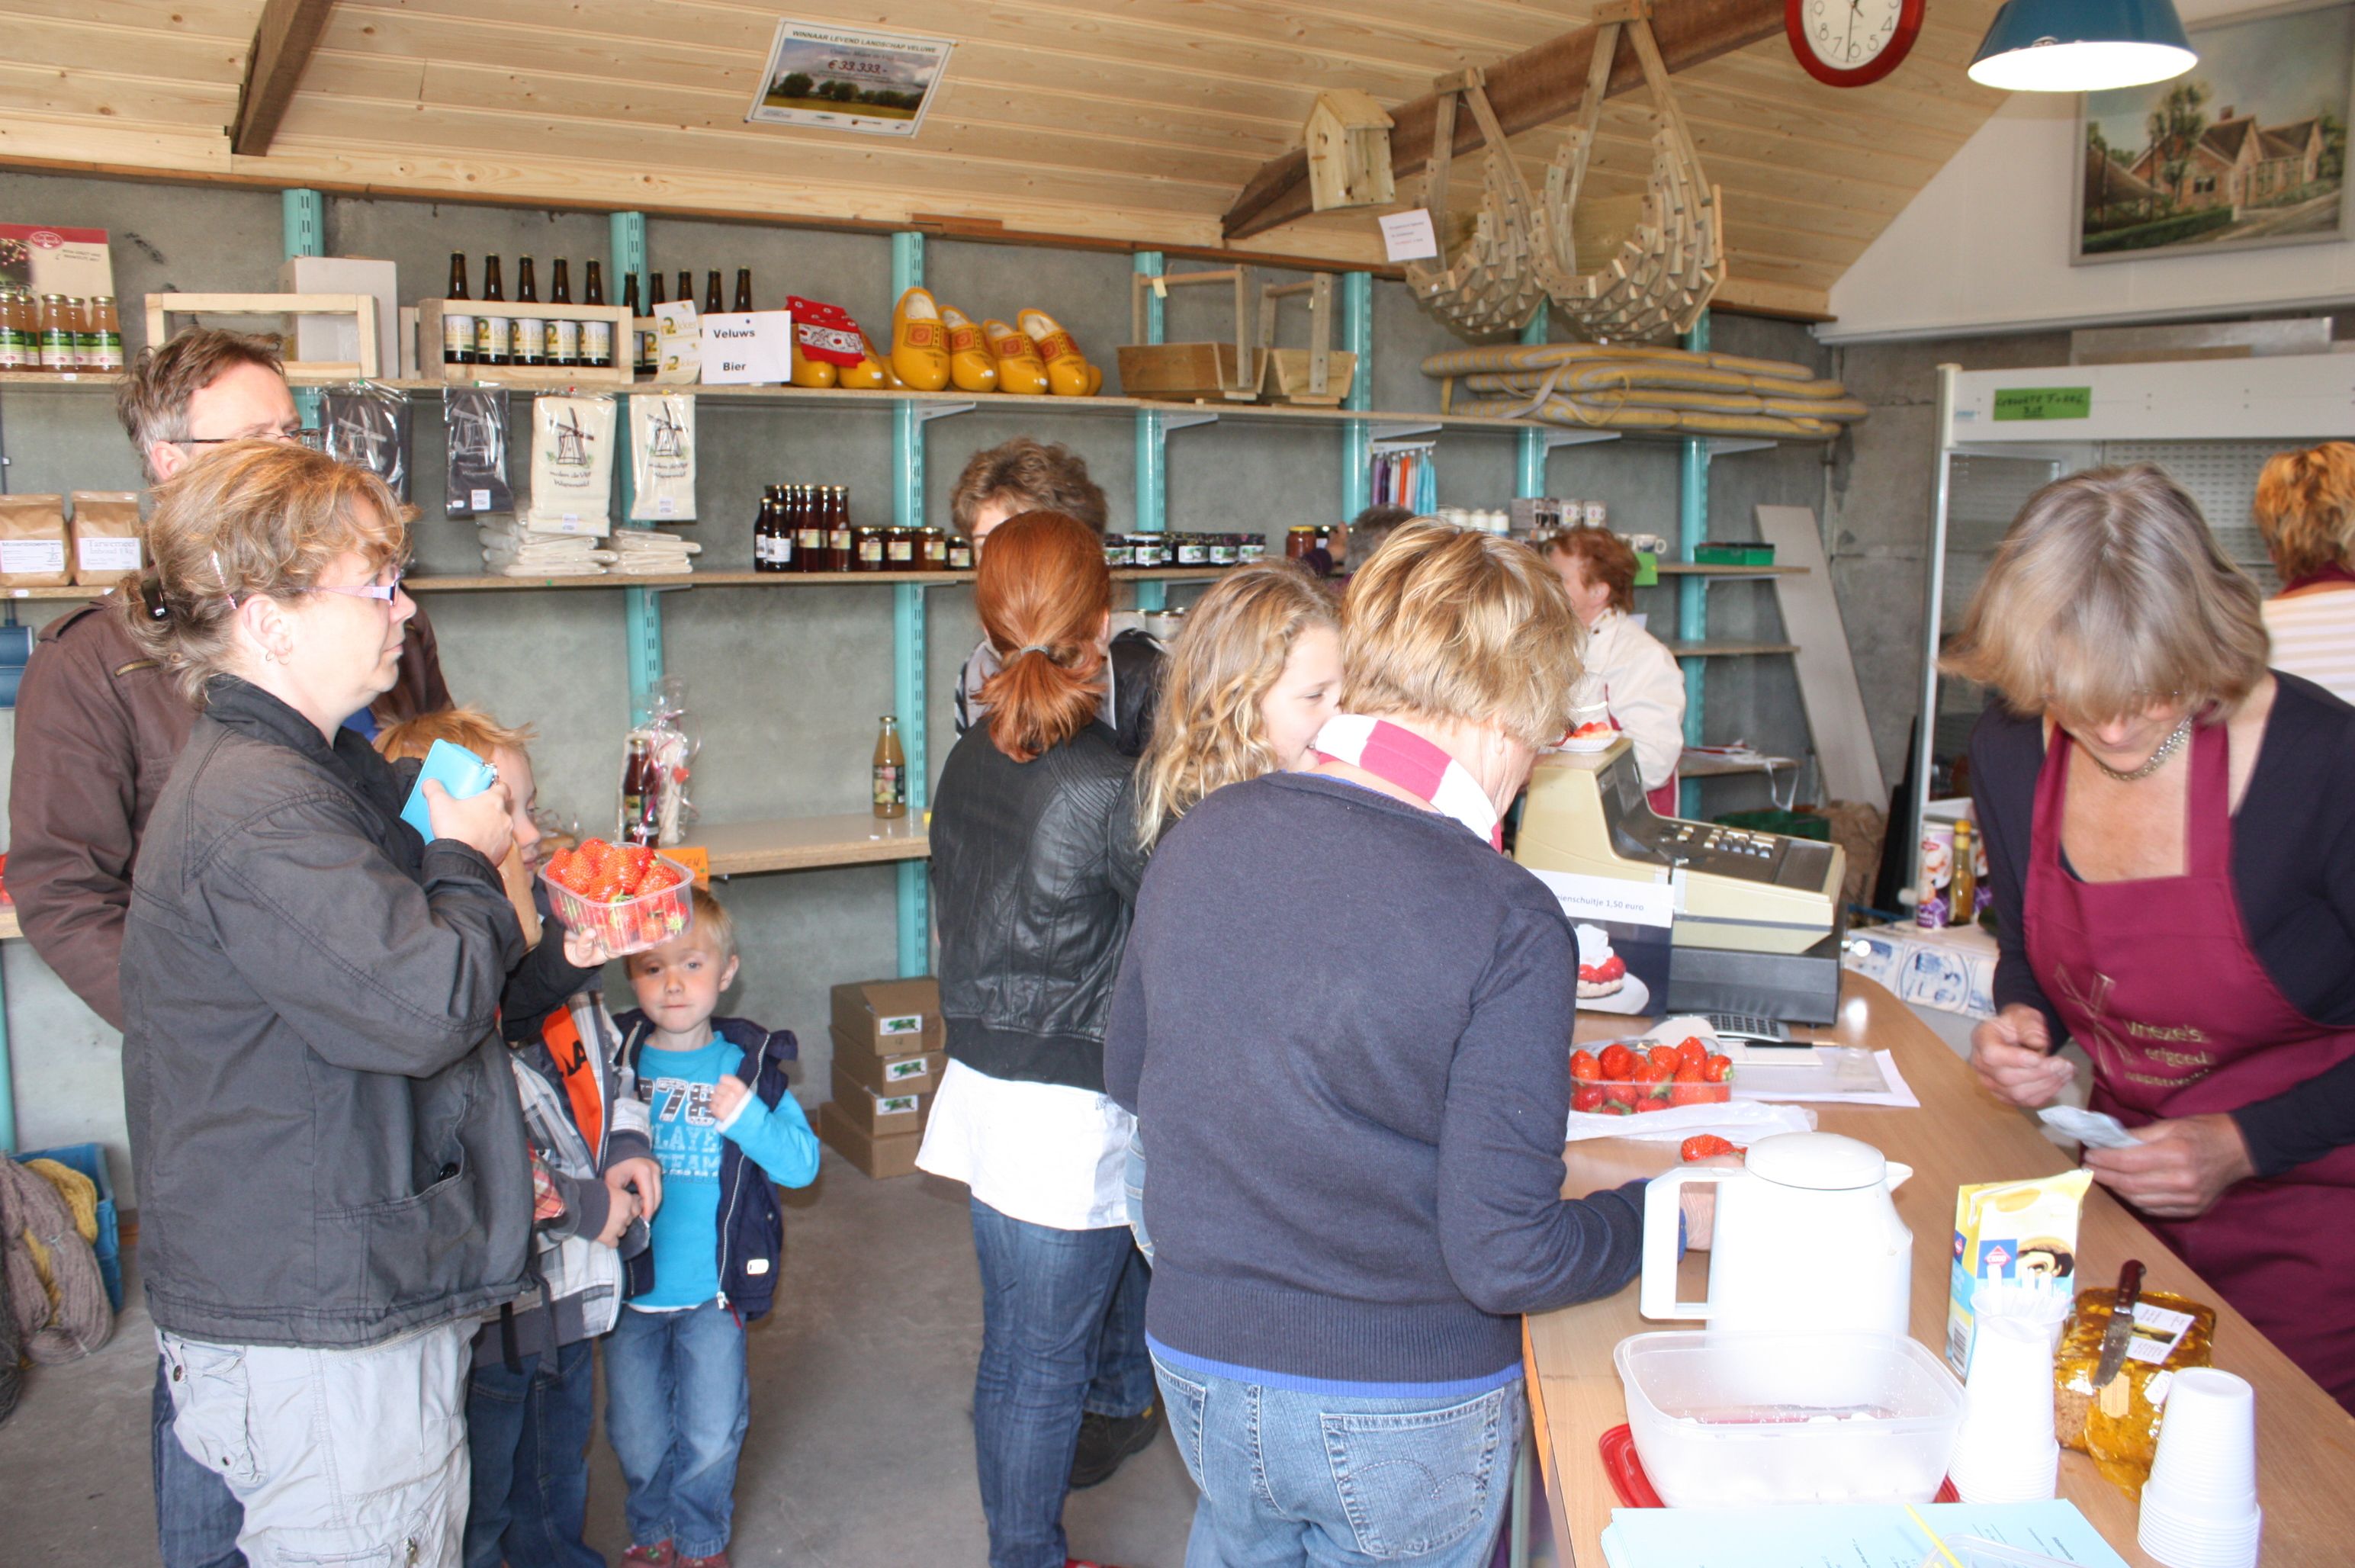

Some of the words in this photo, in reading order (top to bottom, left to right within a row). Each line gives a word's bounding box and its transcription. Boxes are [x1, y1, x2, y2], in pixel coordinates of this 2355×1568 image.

[1881, 15, 1892, 31] 4
[1820, 23, 1830, 41] 8
[792, 30, 828, 41] WINNAAR
[830, 35, 859, 45] LEVEND
[860, 39, 906, 50] LANDSCHAP
[908, 43, 937, 53] VELUWE
[1833, 37, 1843, 53] 7
[1868, 34, 1879, 52] 5
[1849, 41, 1861, 59] 6
[713, 329, 755, 339] Veluws
[723, 362, 746, 371] Bier
[1606, 900, 1623, 909] 1,50
